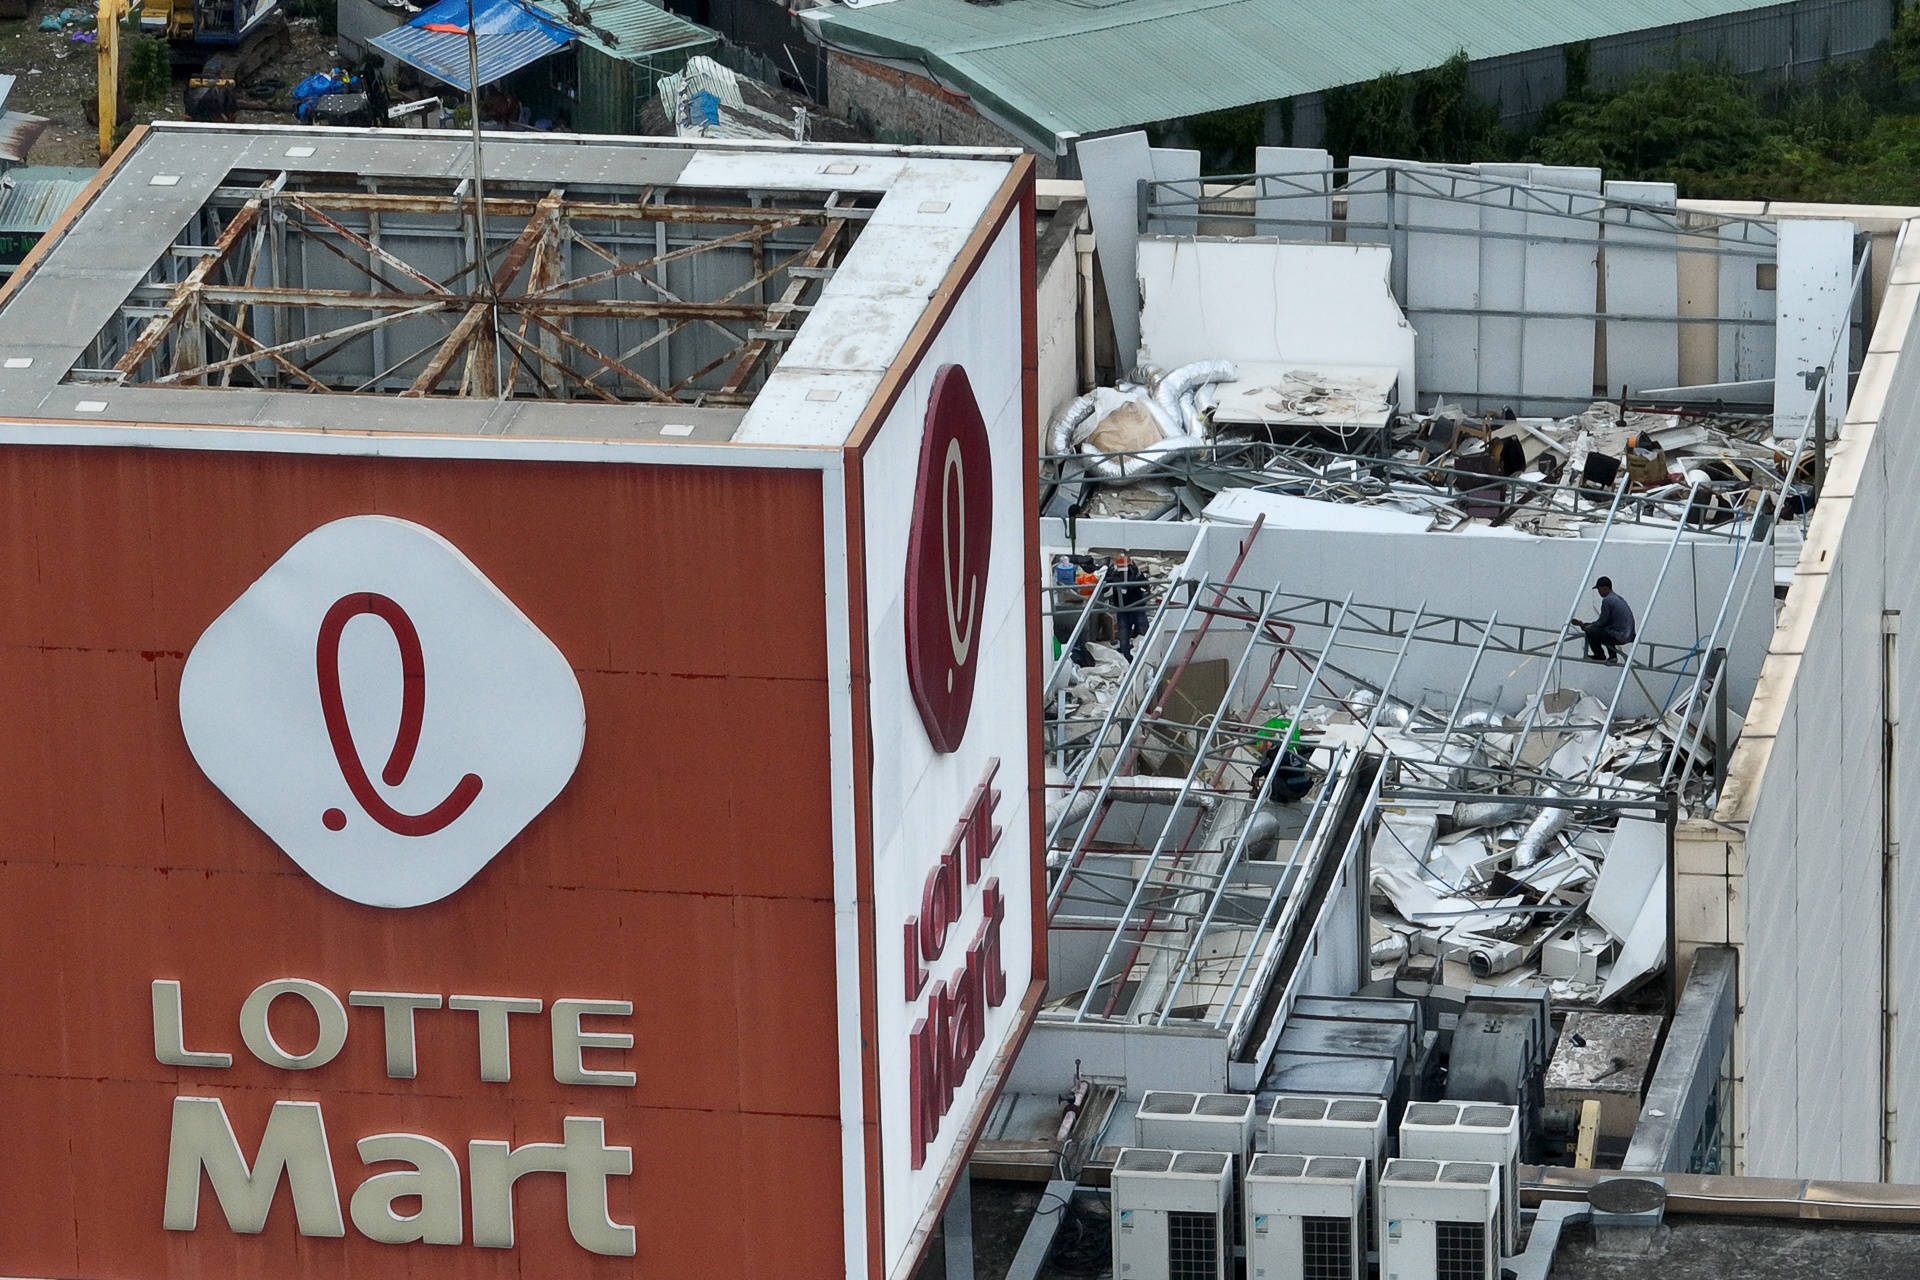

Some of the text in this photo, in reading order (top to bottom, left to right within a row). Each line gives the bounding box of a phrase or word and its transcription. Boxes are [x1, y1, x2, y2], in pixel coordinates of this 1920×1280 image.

[904, 757, 1002, 1001] LOTTE
[151, 977, 637, 1087] LOTTE
[909, 877, 1007, 1170] Mart
[162, 1096, 636, 1257] Mart
